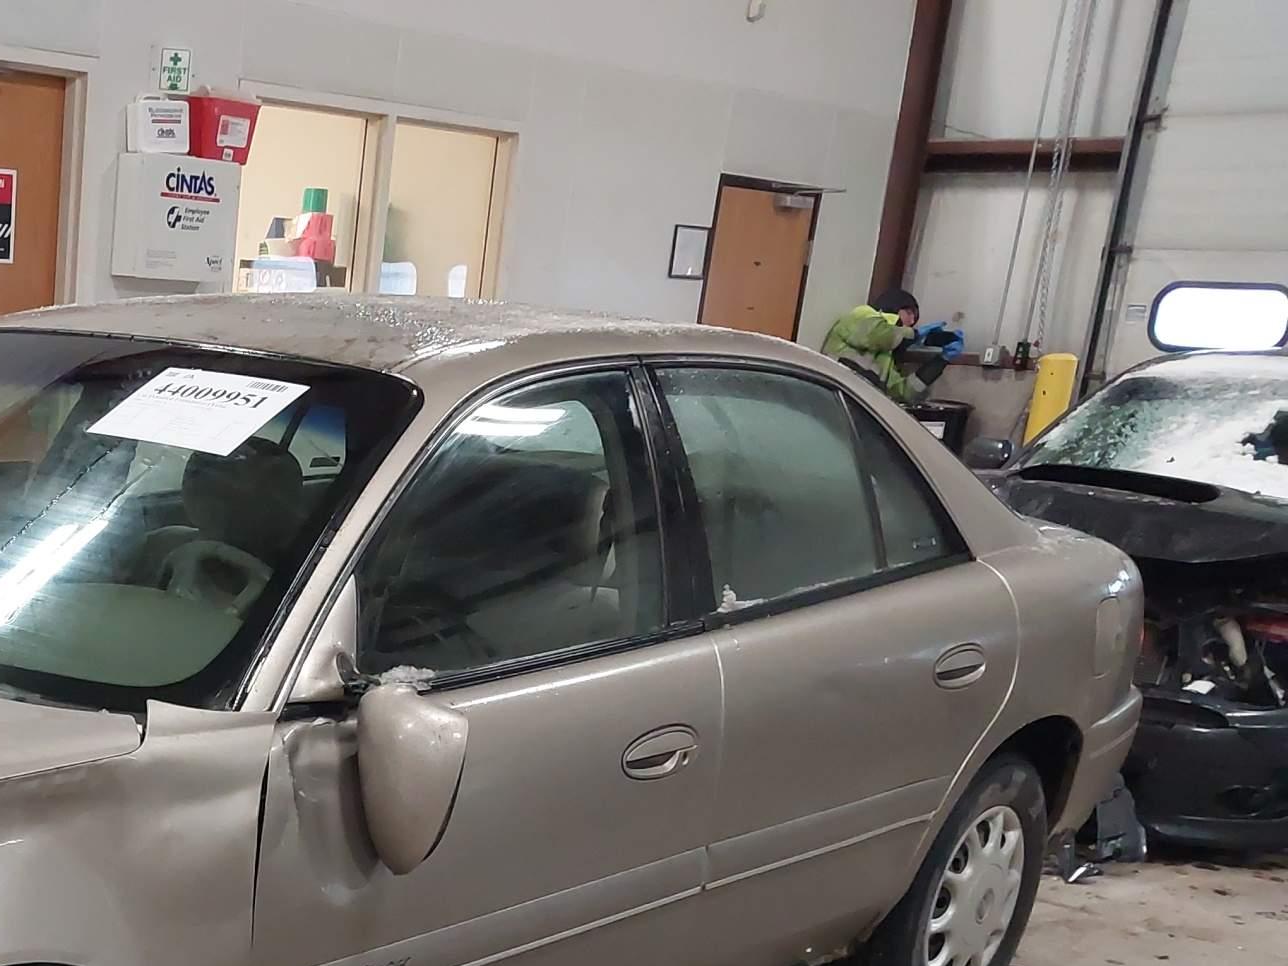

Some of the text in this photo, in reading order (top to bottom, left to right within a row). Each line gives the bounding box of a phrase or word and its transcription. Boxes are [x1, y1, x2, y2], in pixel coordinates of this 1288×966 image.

[163, 66, 187, 75] FIRST
[167, 75, 182, 83] AID
[165, 166, 216, 196] CINTAS
[154, 382, 268, 409] 44009951
